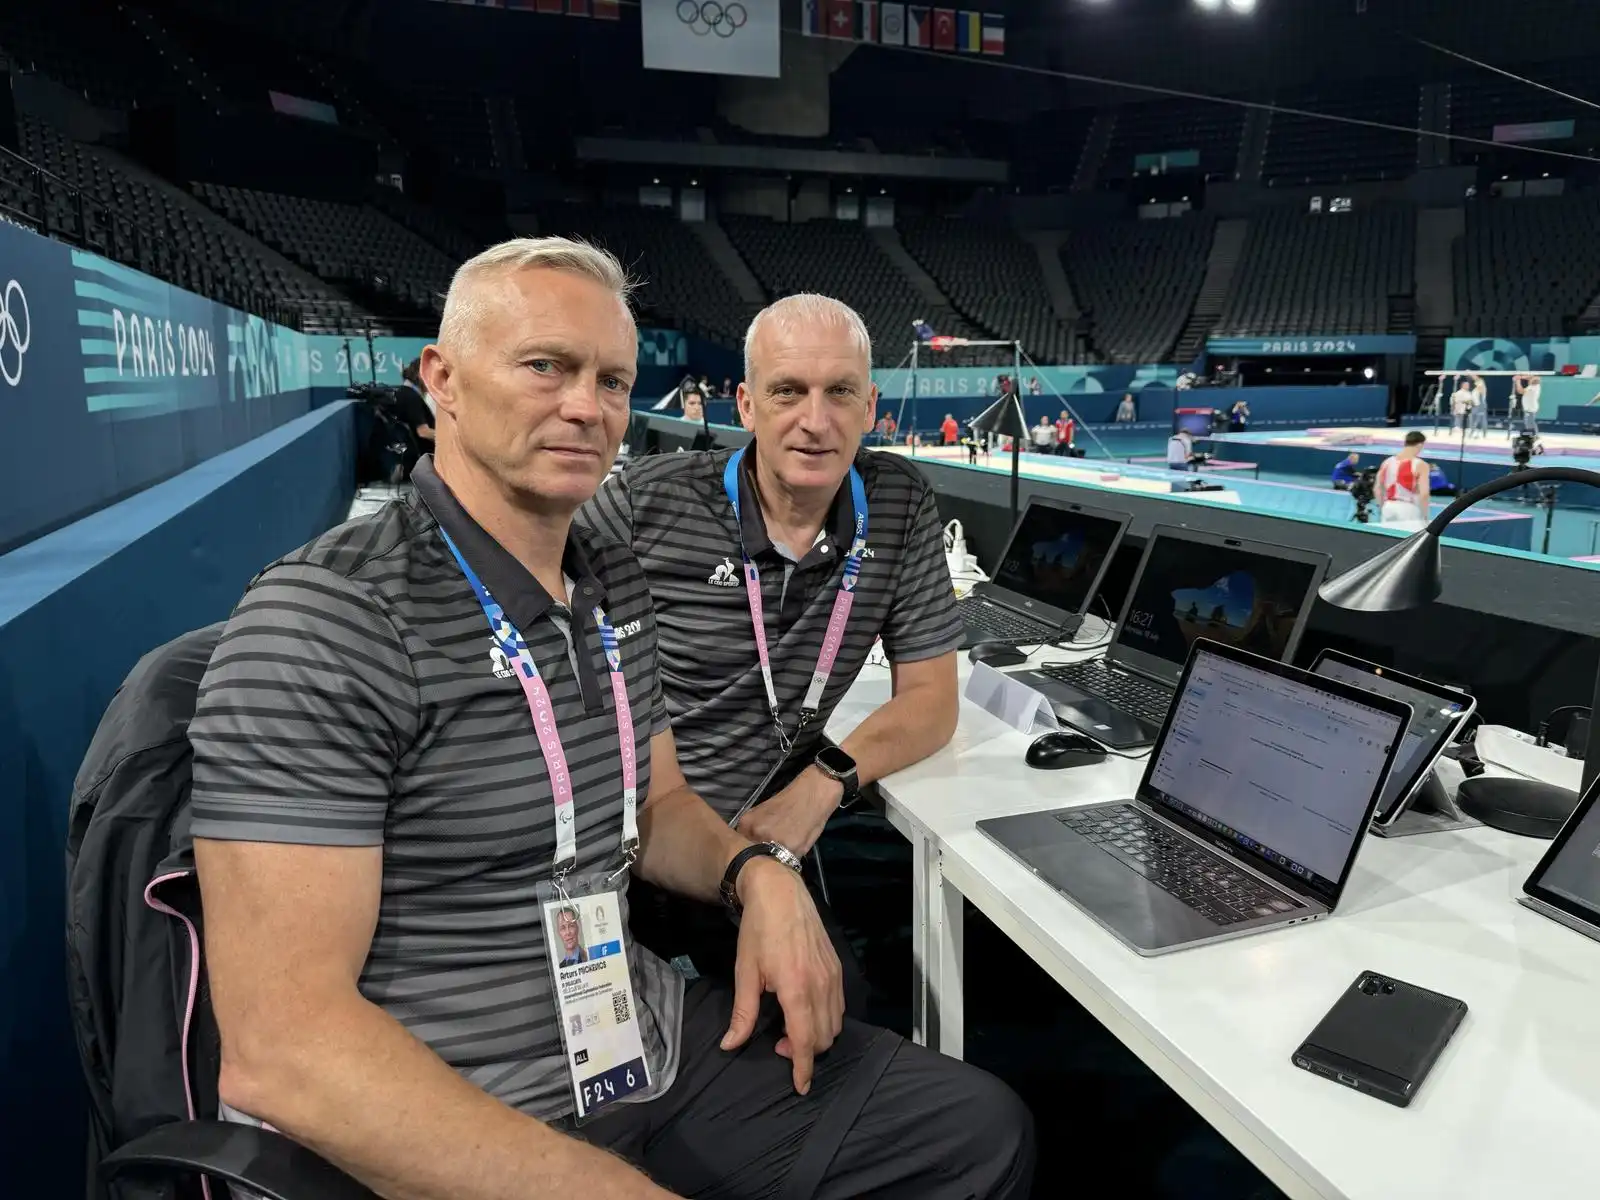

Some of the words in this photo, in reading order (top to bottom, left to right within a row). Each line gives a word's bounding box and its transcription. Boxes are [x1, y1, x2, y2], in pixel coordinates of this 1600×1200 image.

[179, 323, 216, 376] 2024
[335, 349, 403, 374] 2024
[1312, 341, 1356, 353] 2024
[532, 686, 553, 735] 2024
[576, 1052, 587, 1063] ALL
[583, 1078, 615, 1107] F24
[626, 1068, 636, 1088] 6
